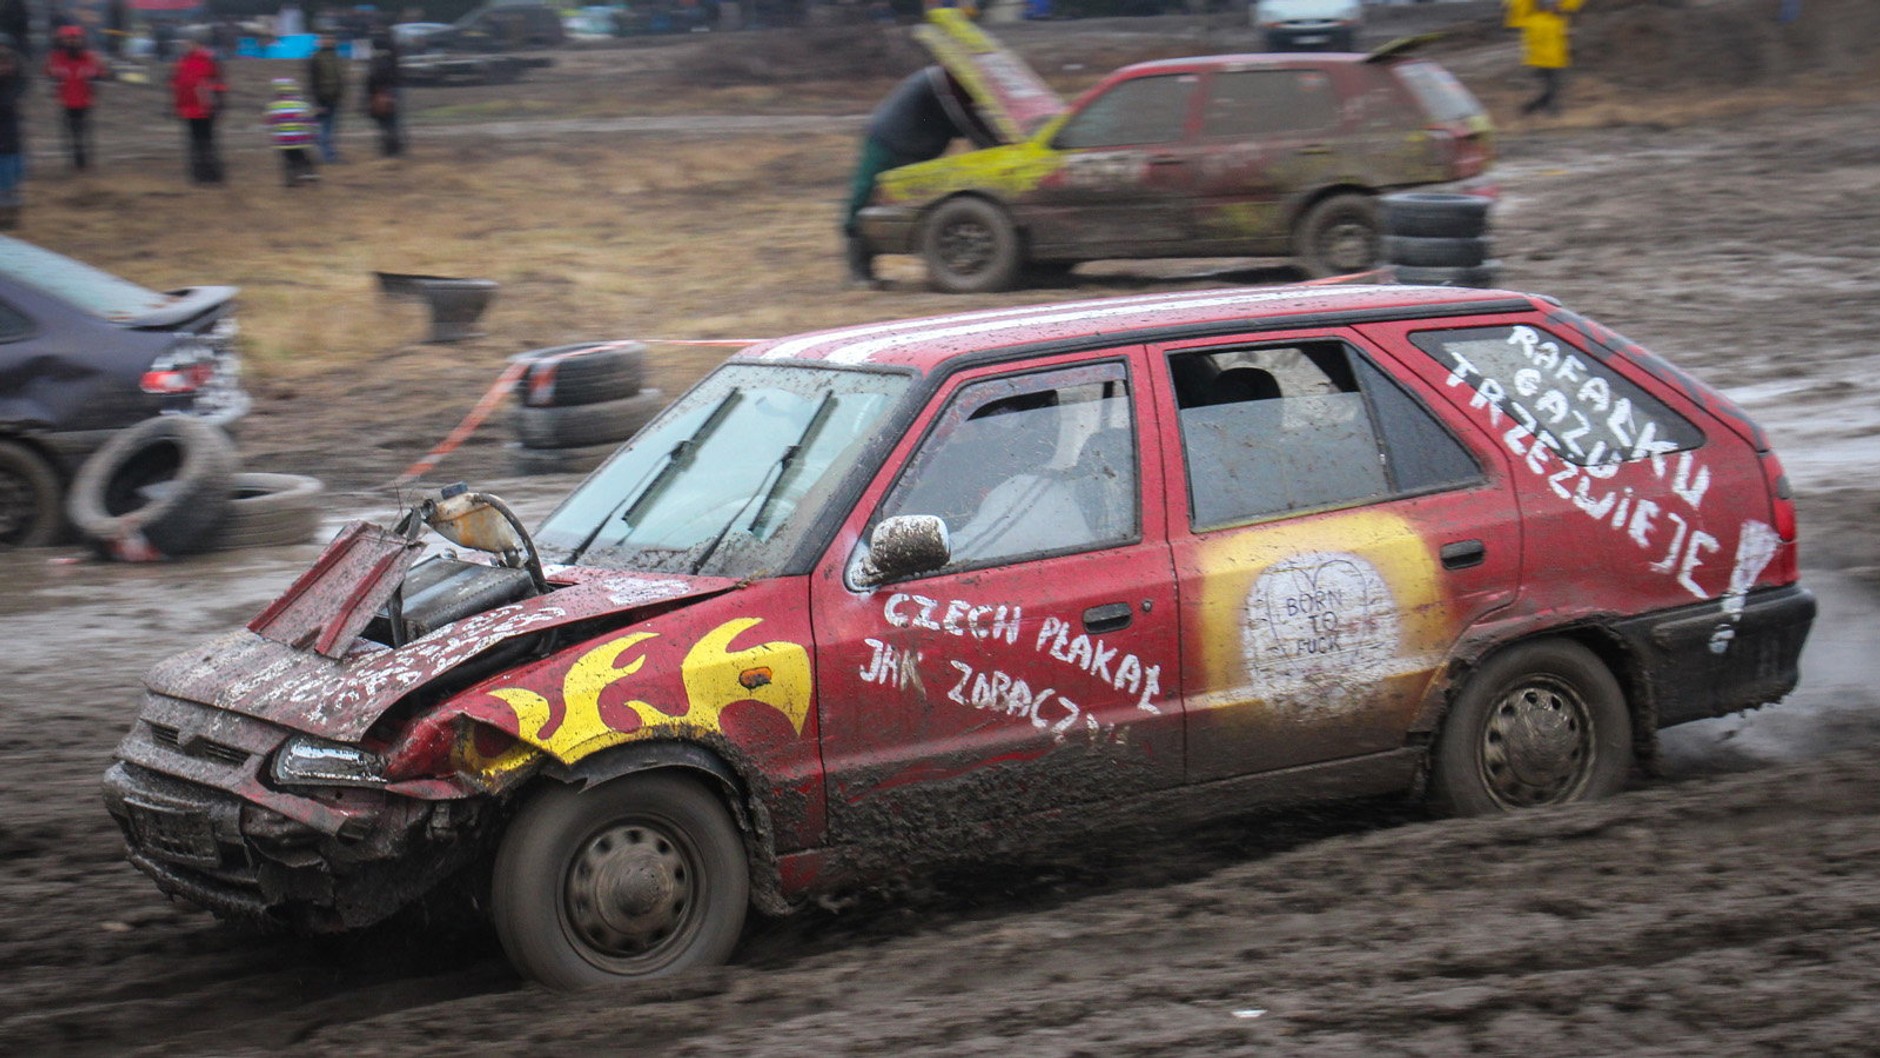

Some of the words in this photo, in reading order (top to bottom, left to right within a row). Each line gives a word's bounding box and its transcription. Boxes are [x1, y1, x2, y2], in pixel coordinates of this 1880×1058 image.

[1514, 368, 1623, 479] GAZU
[1285, 588, 1343, 617] BORN
[884, 593, 1021, 644] CZECH
[1308, 610, 1339, 634] TO
[1296, 634, 1342, 655] FUCK
